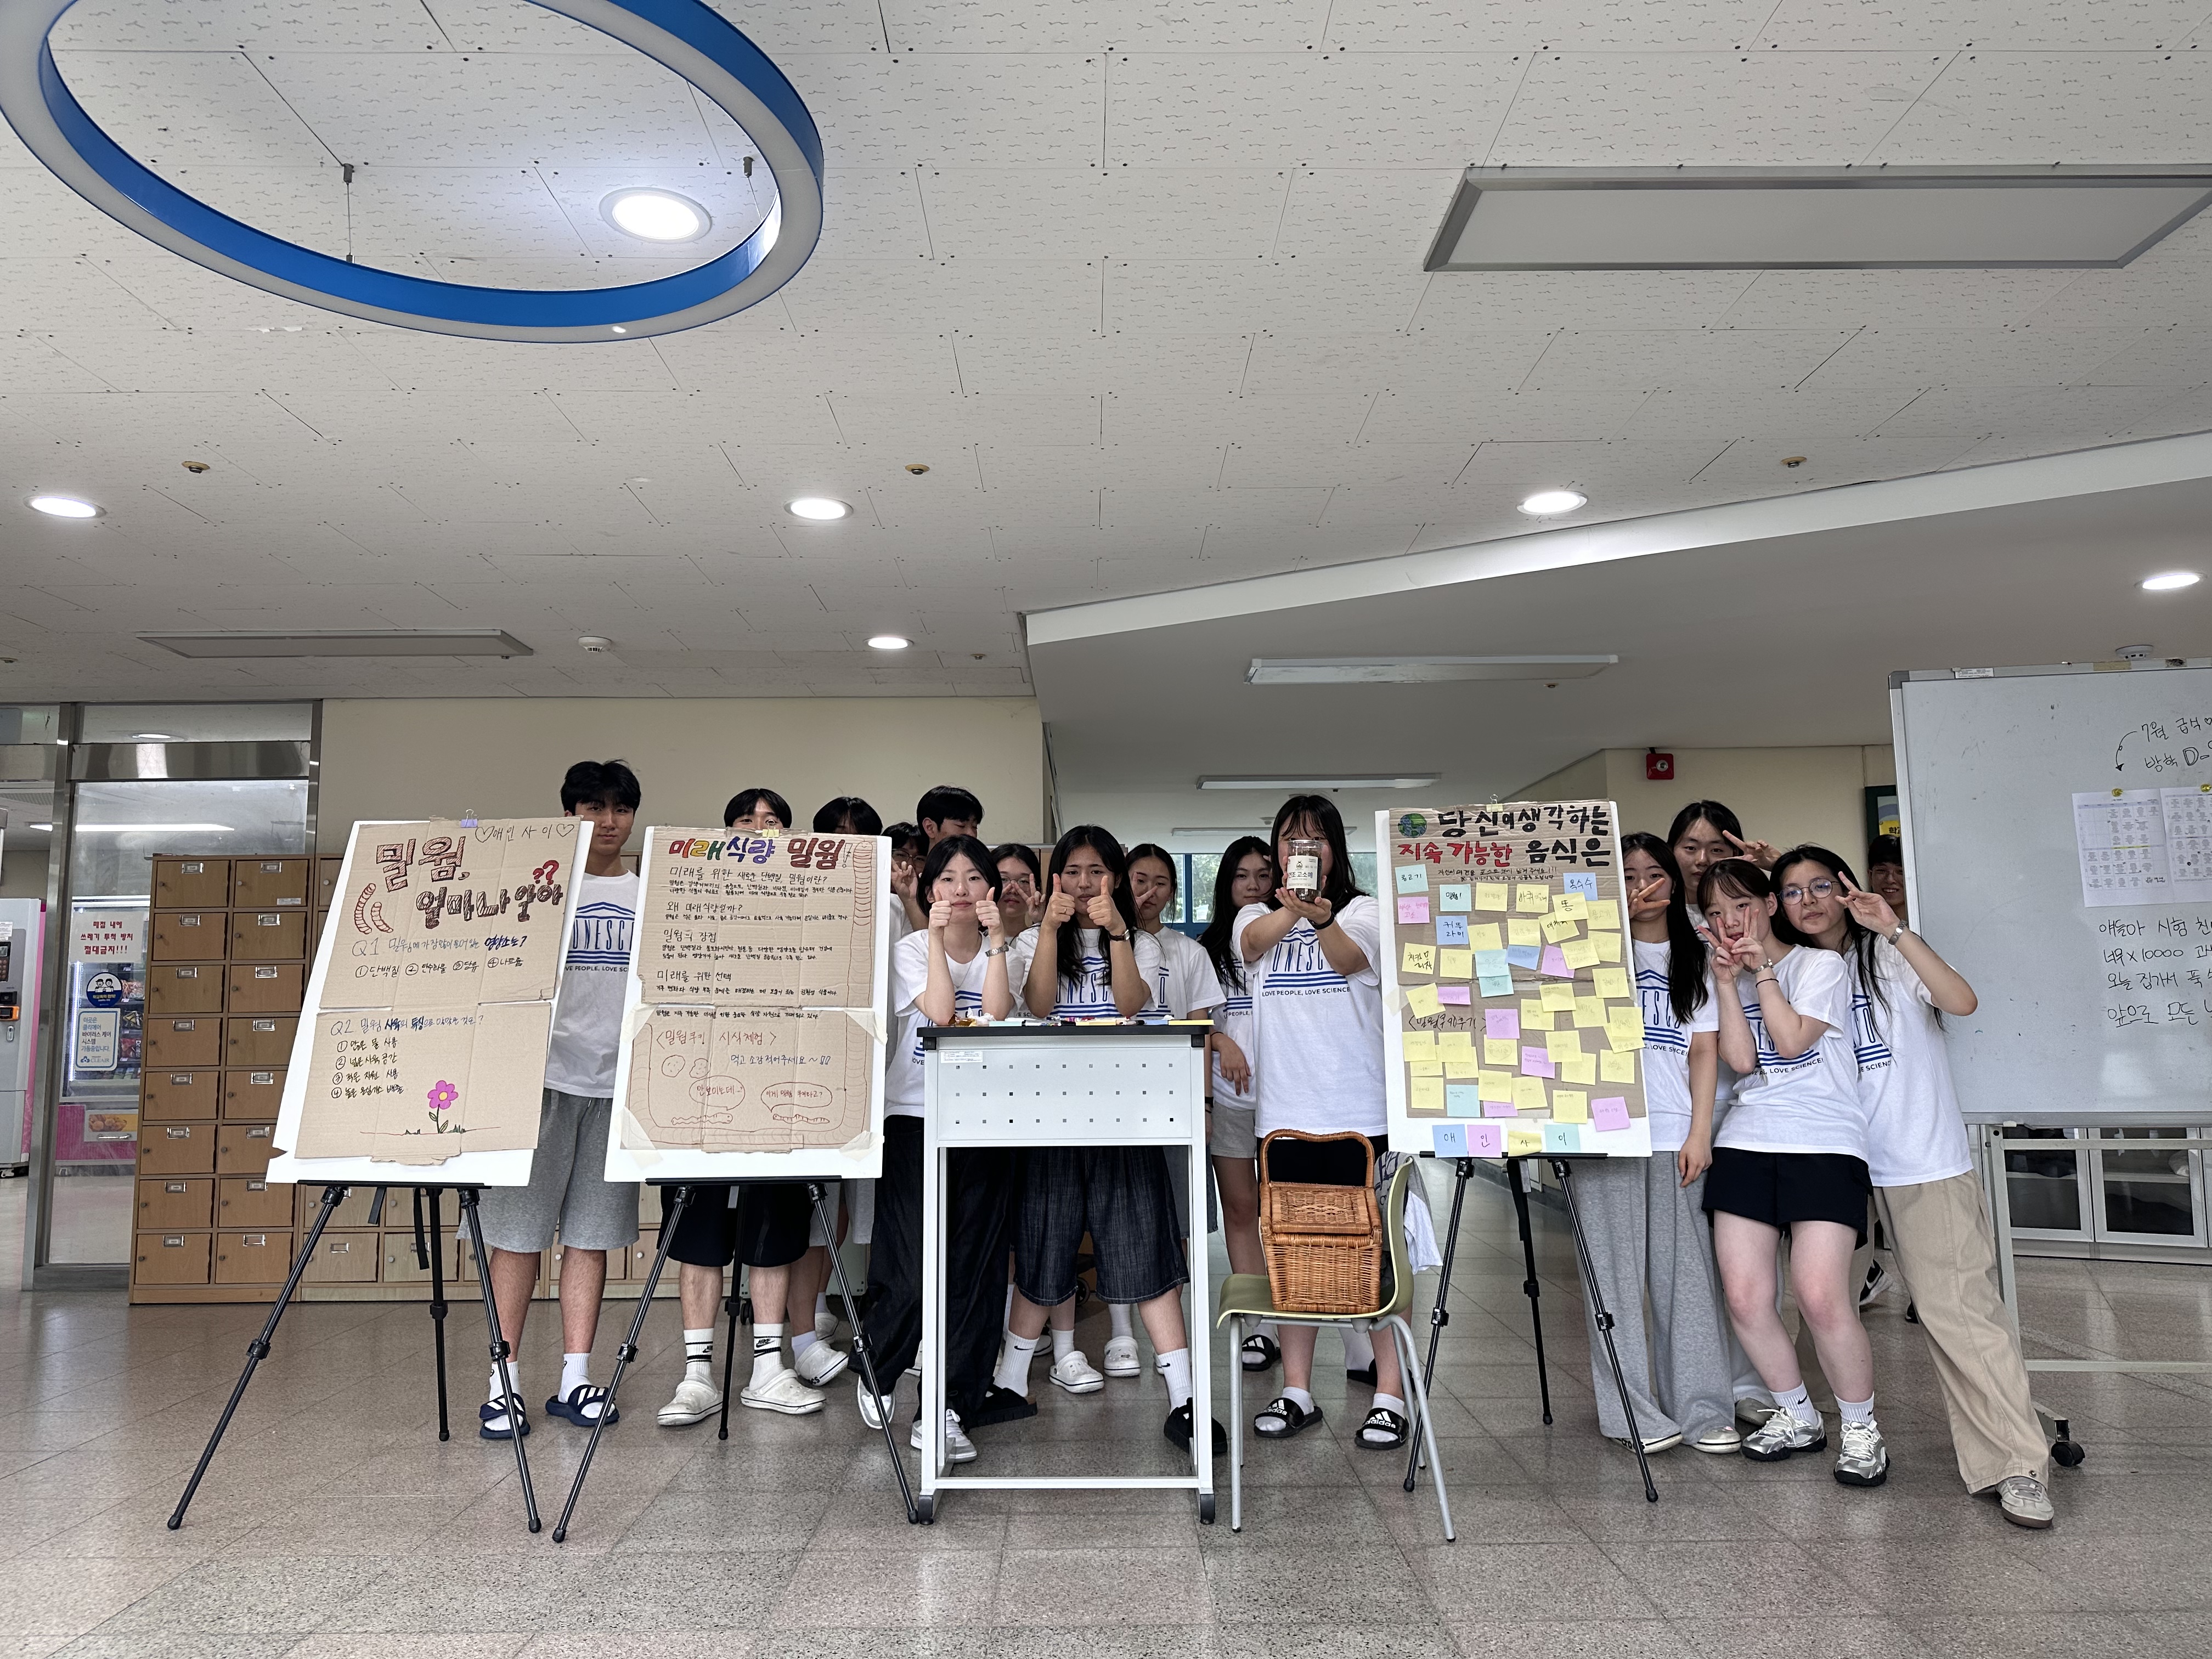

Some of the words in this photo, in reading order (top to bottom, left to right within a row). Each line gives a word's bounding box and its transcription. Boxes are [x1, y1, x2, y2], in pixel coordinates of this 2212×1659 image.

[2141, 721, 2169, 742] 7월
[2175, 717, 2201, 734] 급식
[2145, 753, 2178, 772] 방학
[1397, 841, 1443, 865] 지속
[1447, 840, 1513, 867] 가능한
[1525, 838, 1611, 867] 음식은
[669, 867, 705, 881] 미래를
[710, 868, 733, 881] 위한
[737, 871, 757, 882] 새로운
[1570, 877, 1593, 890] 옥수수
[416, 886, 511, 929] 얼마나
[515, 884, 563, 922] 알아
[666, 901, 679, 912] 왜
[1561, 900, 1574, 911] 똥
[2099, 919, 2146, 937] 얘들아
[2158, 917, 2187, 937] 시험
[664, 928, 693, 943] 밀웜의
[698, 931, 716, 943] 장점
[84, 945, 127, 955] 절대금지!!!
[352, 937, 379, 956] Q1
[1272, 941, 1323, 972] UNESC
[657, 969, 690, 983] 미래를
[693, 971, 712, 981] 위한
[715, 972, 731, 981] 선택
[2108, 972, 2134, 991] 오늘
[2186, 969, 2203, 989] 푹
[1056, 969, 1108, 1004] UNESC
[2107, 1003, 2159, 1028] 앞으로
[2168, 1002, 2199, 1025] 모든
[330, 1019, 354, 1036] Q2
[371, 1039, 380, 1049] 물
[384, 1036, 398, 1048] 사용
[381, 1052, 398, 1065] 공간
[731, 1053, 745, 1065] 먹고
[749, 1054, 763, 1065] 소감
[386, 1068, 399, 1080] 사용
[1443, 1132, 1455, 1143] 애
[1481, 1133, 1490, 1148] 인
[1520, 1139, 1530, 1148] 사
